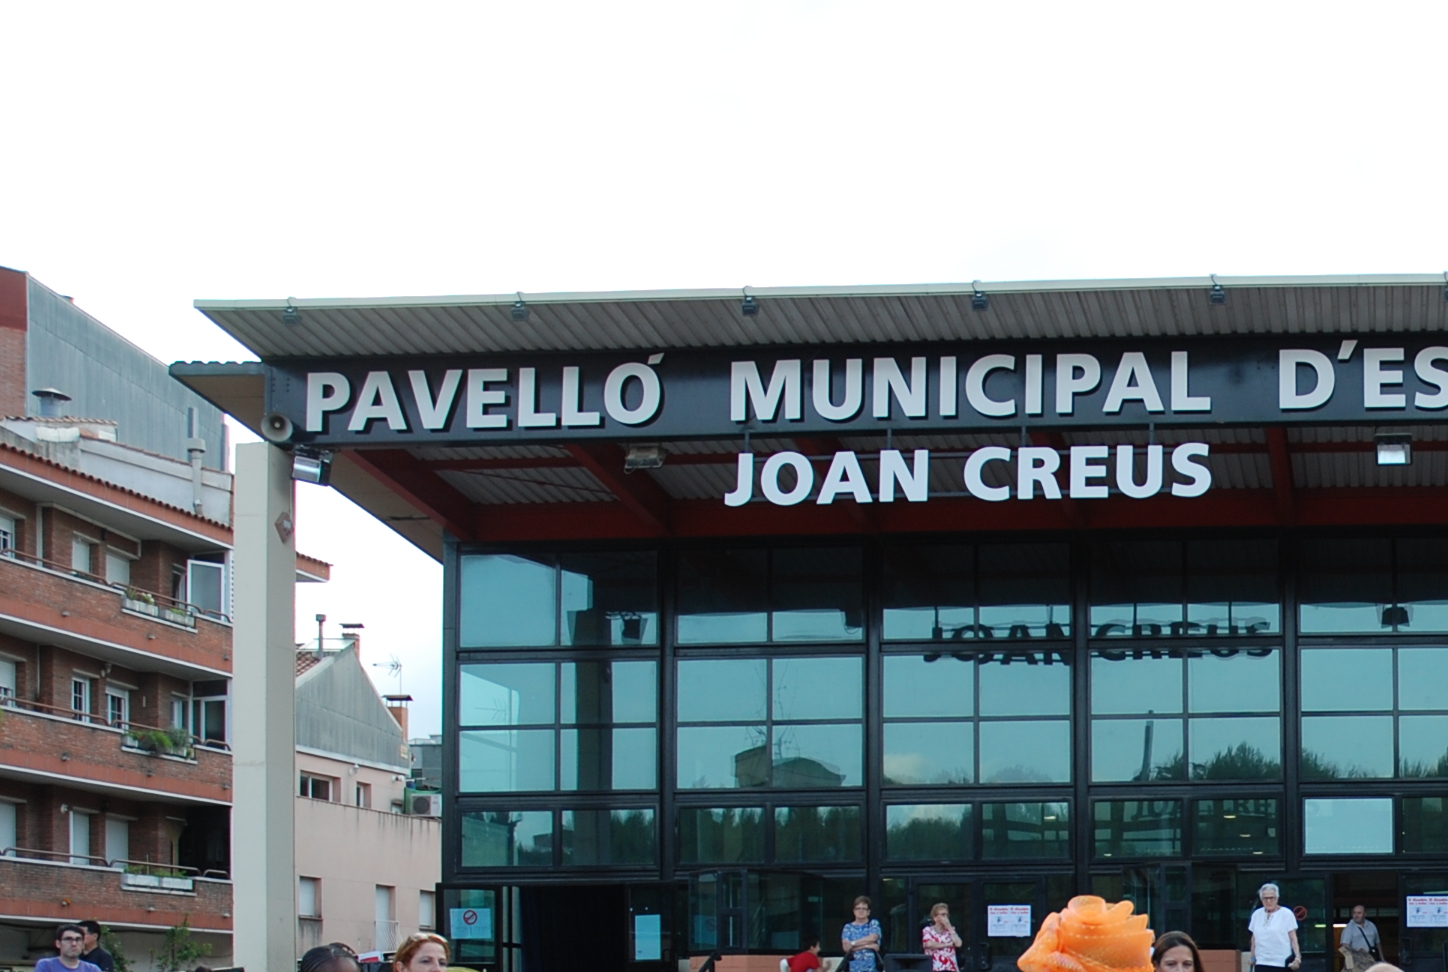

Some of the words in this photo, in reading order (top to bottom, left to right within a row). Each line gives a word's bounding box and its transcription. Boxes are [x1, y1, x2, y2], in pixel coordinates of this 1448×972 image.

[304, 352, 664, 433] PAVELLÓ
[729, 350, 1212, 423] MUNICIPAL
[724, 448, 930, 508] JOAN
[963, 441, 1213, 502] CREUS
